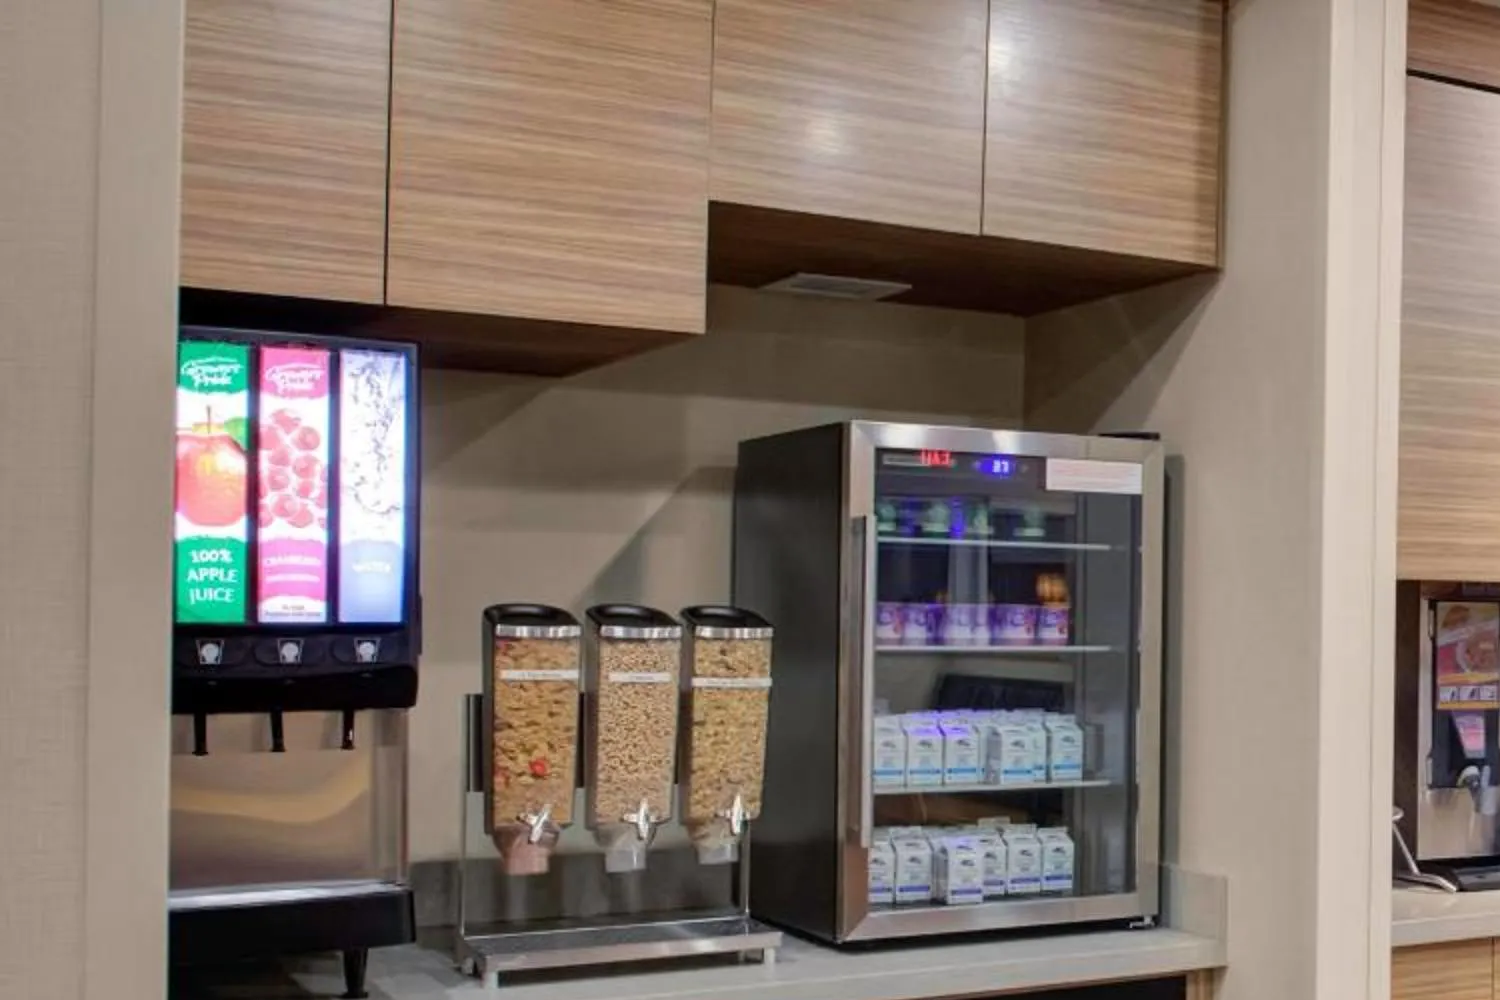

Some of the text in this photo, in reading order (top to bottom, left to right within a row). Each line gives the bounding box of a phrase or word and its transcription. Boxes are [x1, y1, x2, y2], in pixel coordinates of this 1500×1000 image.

[190, 549, 232, 564] 100%
[187, 568, 237, 583] APPLE
[189, 586, 235, 604] JUICE
